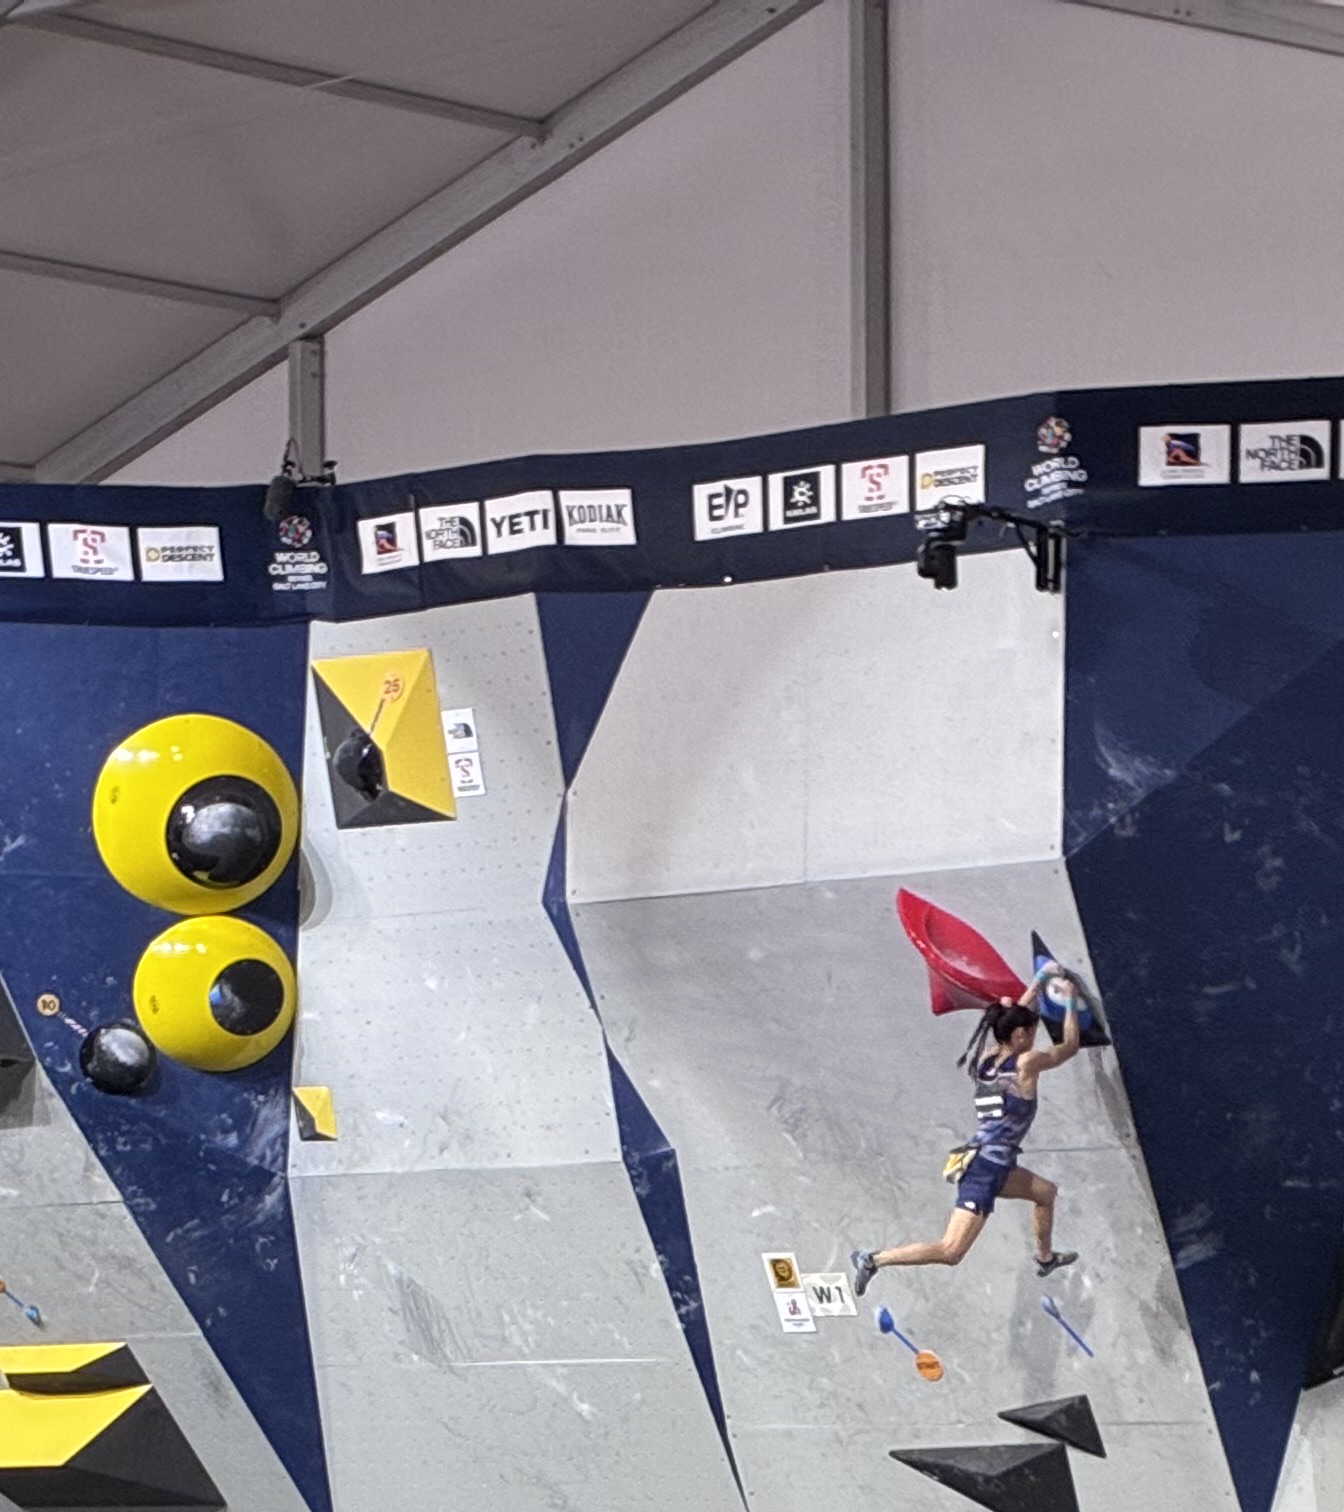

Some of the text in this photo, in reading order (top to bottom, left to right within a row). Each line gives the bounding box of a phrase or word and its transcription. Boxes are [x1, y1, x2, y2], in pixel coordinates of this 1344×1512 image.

[1268, 434, 1300, 449] THE
[1031, 456, 1080, 476] WORLD
[437, 516, 459, 529] THE
[565, 504, 629, 527] KODIAK
[490, 508, 551, 538] YETI
[434, 539, 460, 550] FACE
[161, 553, 216, 563] DESCENT
[274, 552, 321, 563] WORLD
[268, 563, 329, 575] CLIMBING
[811, 1285, 846, 1304] W1
